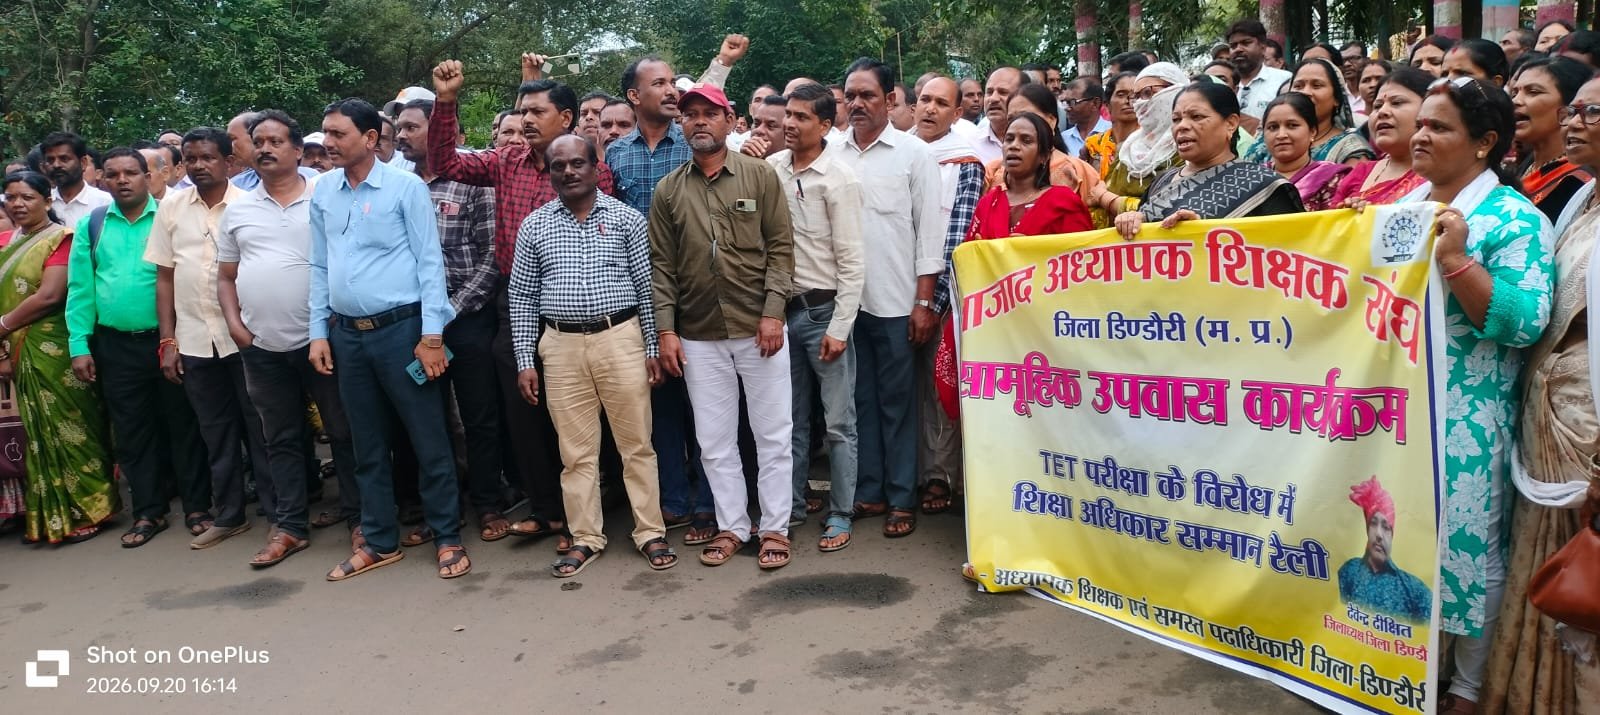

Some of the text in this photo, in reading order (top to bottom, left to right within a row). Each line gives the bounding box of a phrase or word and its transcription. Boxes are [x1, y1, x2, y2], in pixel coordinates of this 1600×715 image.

[1043, 242, 1193, 293] अध्यापक
[1205, 229, 1349, 309] शिक्षक
[1363, 271, 1421, 364] संघ
[1053, 310, 1100, 338] जिला
[1106, 310, 1186, 342] डिण्डौरी
[961, 351, 1409, 445] सामूहिक उपवास कार्यक्रम
[1039, 449, 1297, 525] TET परीक्षा के विरोध में
[1012, 481, 1329, 582] शिक्षा अधिकार सम्मान रैली
[1077, 576, 1124, 610] शिक्षक
[1126, 597, 1150, 620] एवं
[1152, 604, 1205, 639] समस्त
[1208, 621, 1305, 667] पदाधिकारी
[1365, 630, 1391, 652] जिला
[1394, 639, 1428, 662] डिण्डौ
[1372, 613, 1413, 639] दीक्षित
